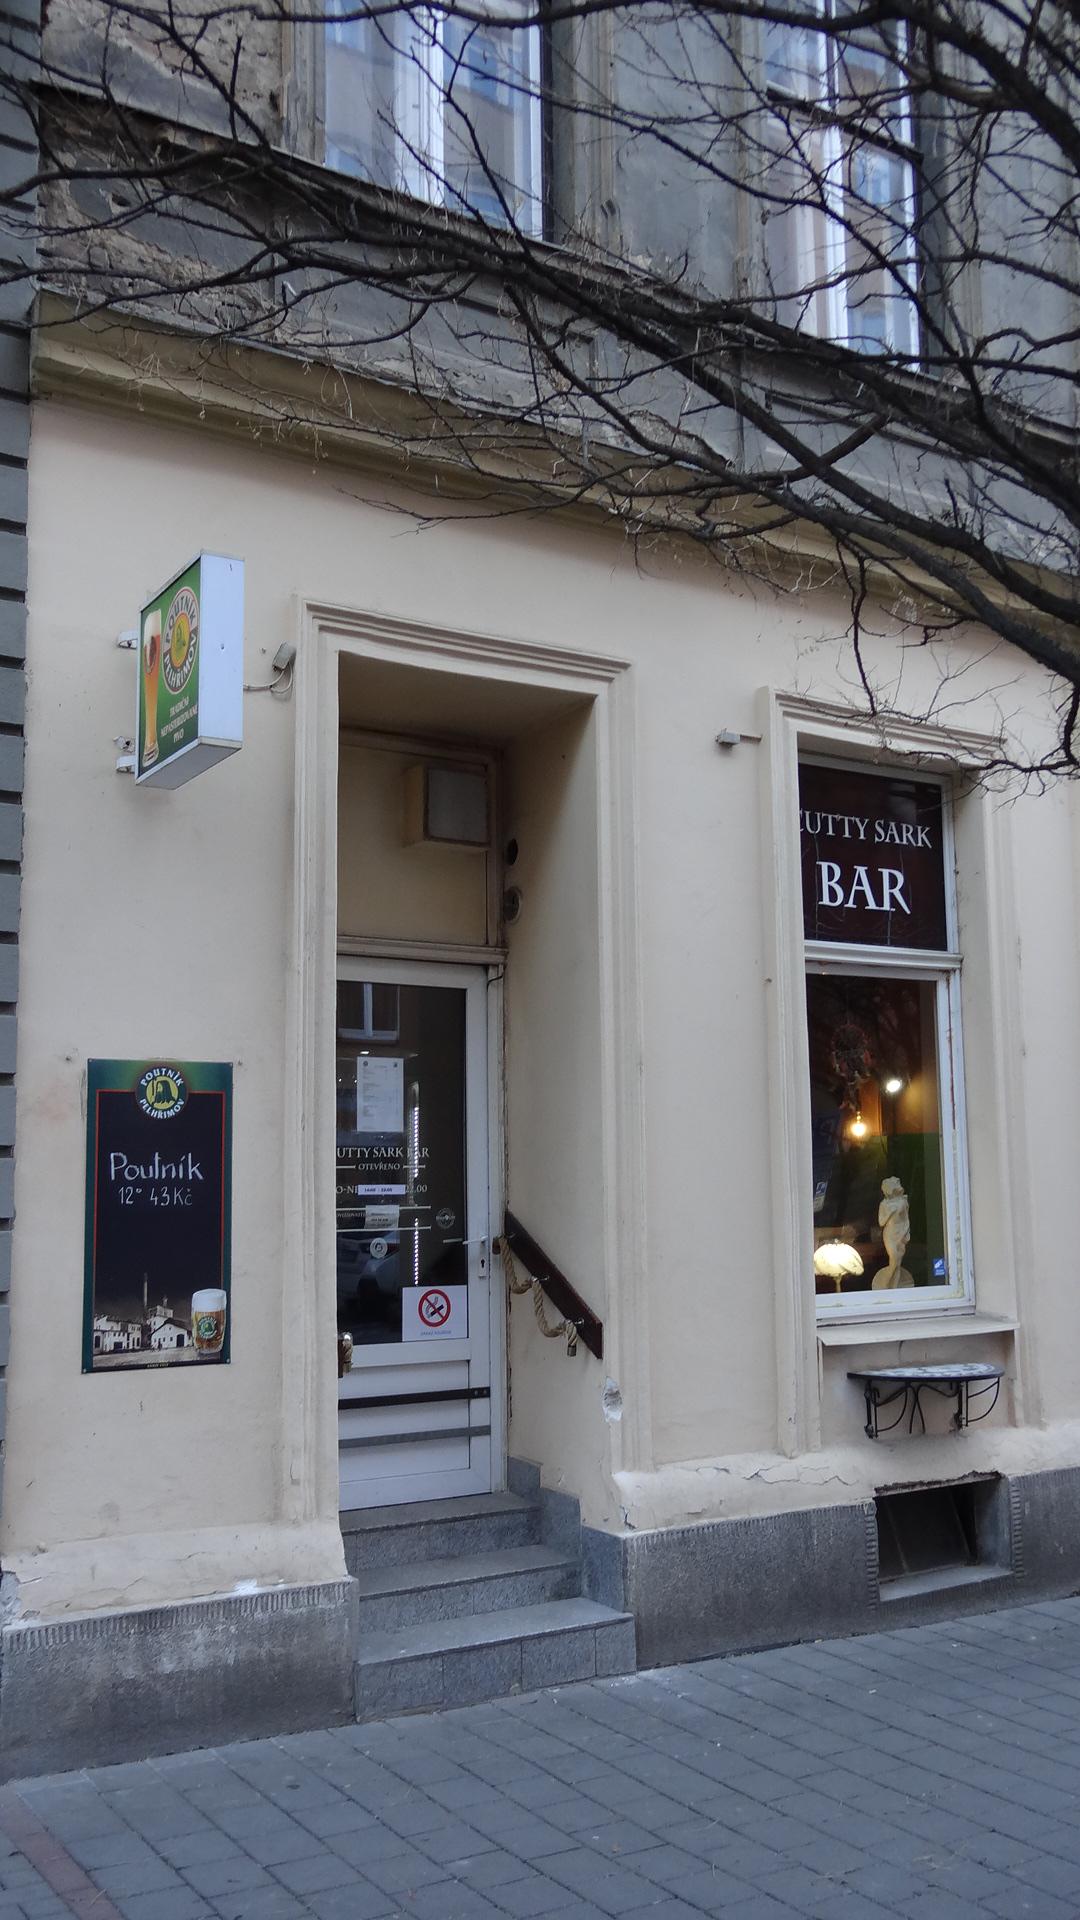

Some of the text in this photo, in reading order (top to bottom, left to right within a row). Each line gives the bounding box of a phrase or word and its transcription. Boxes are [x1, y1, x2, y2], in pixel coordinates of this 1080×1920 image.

[800, 808, 932, 849] UTTY SARK
[816, 861, 911, 915] BAR
[336, 1147, 371, 1158] UTTY
[373, 1147, 404, 1158] SARK
[110, 1152, 203, 1180] Poutník
[358, 1161, 400, 1171] OTEVŘENO
[119, 1186, 142, 1204] 12°
